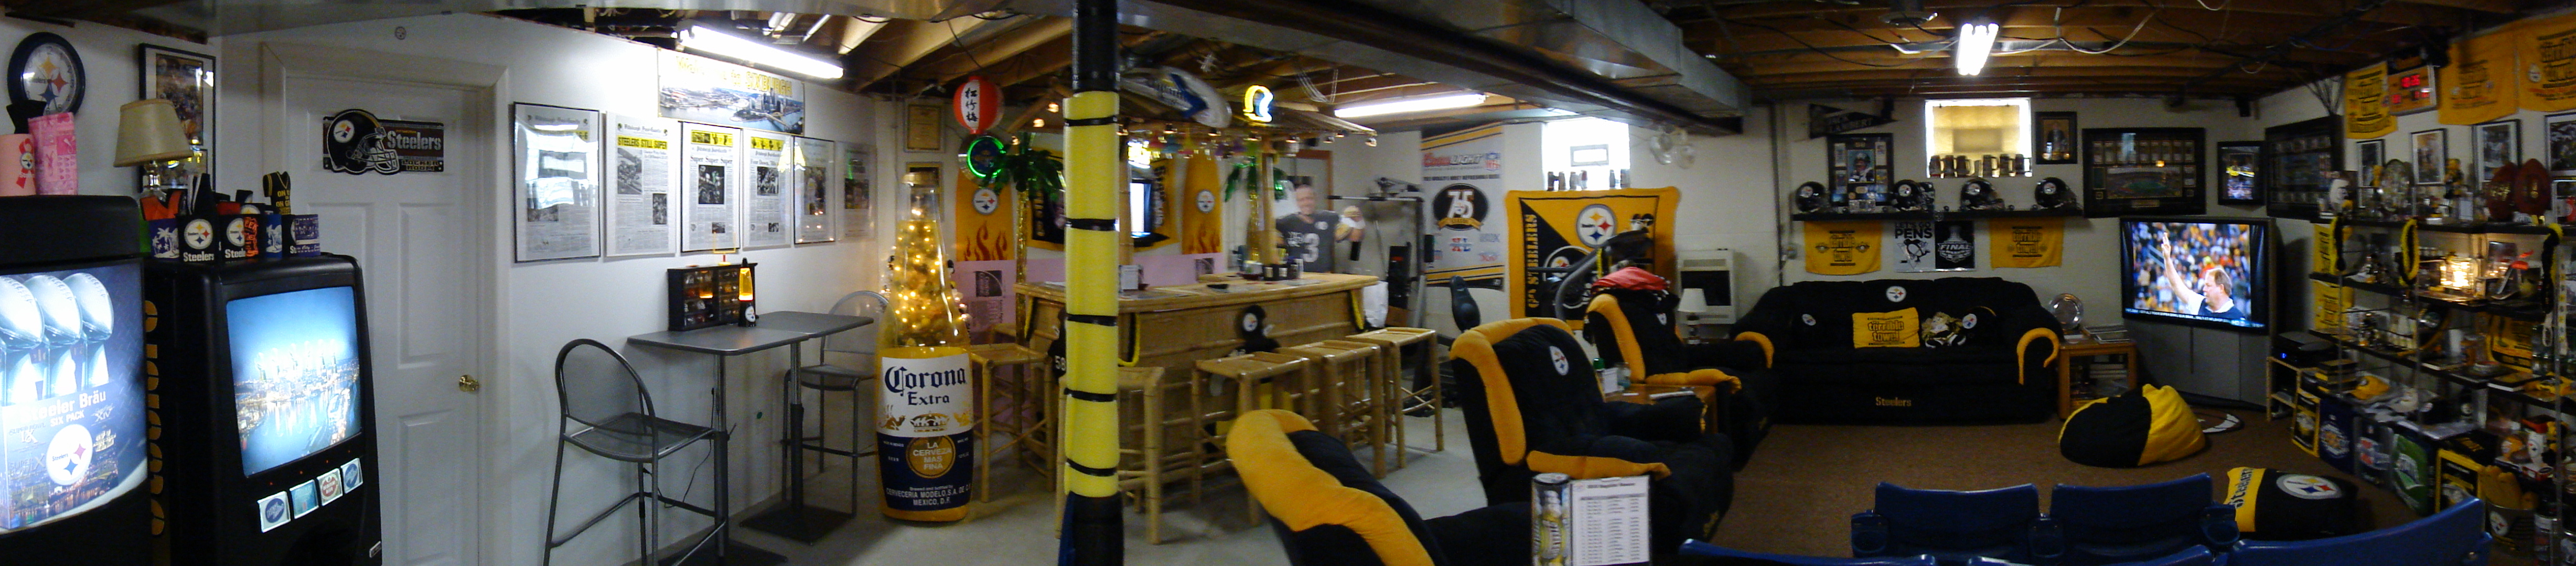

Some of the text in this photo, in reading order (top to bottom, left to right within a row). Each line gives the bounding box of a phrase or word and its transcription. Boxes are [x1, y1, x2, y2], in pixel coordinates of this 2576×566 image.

[387, 130, 442, 151] Steelers
[618, 137, 668, 150] STEELERS STILL SUPER
[1447, 189, 1474, 219] 75
[1895, 228, 1933, 239] PENS
[183, 252, 214, 262] Steelers
[224, 248, 246, 259] Steel
[1867, 320, 1904, 331] terrible
[1872, 331, 1899, 342] towel
[884, 366, 967, 396] Corona
[79, 389, 106, 409] Bräu
[907, 391, 950, 406] Extra
[1875, 396, 1912, 407] Steelers
[50, 409, 85, 427] SIX PACK
[913, 448, 952, 456] CERVEZA
[886, 487, 918, 498] CERVECERIA
